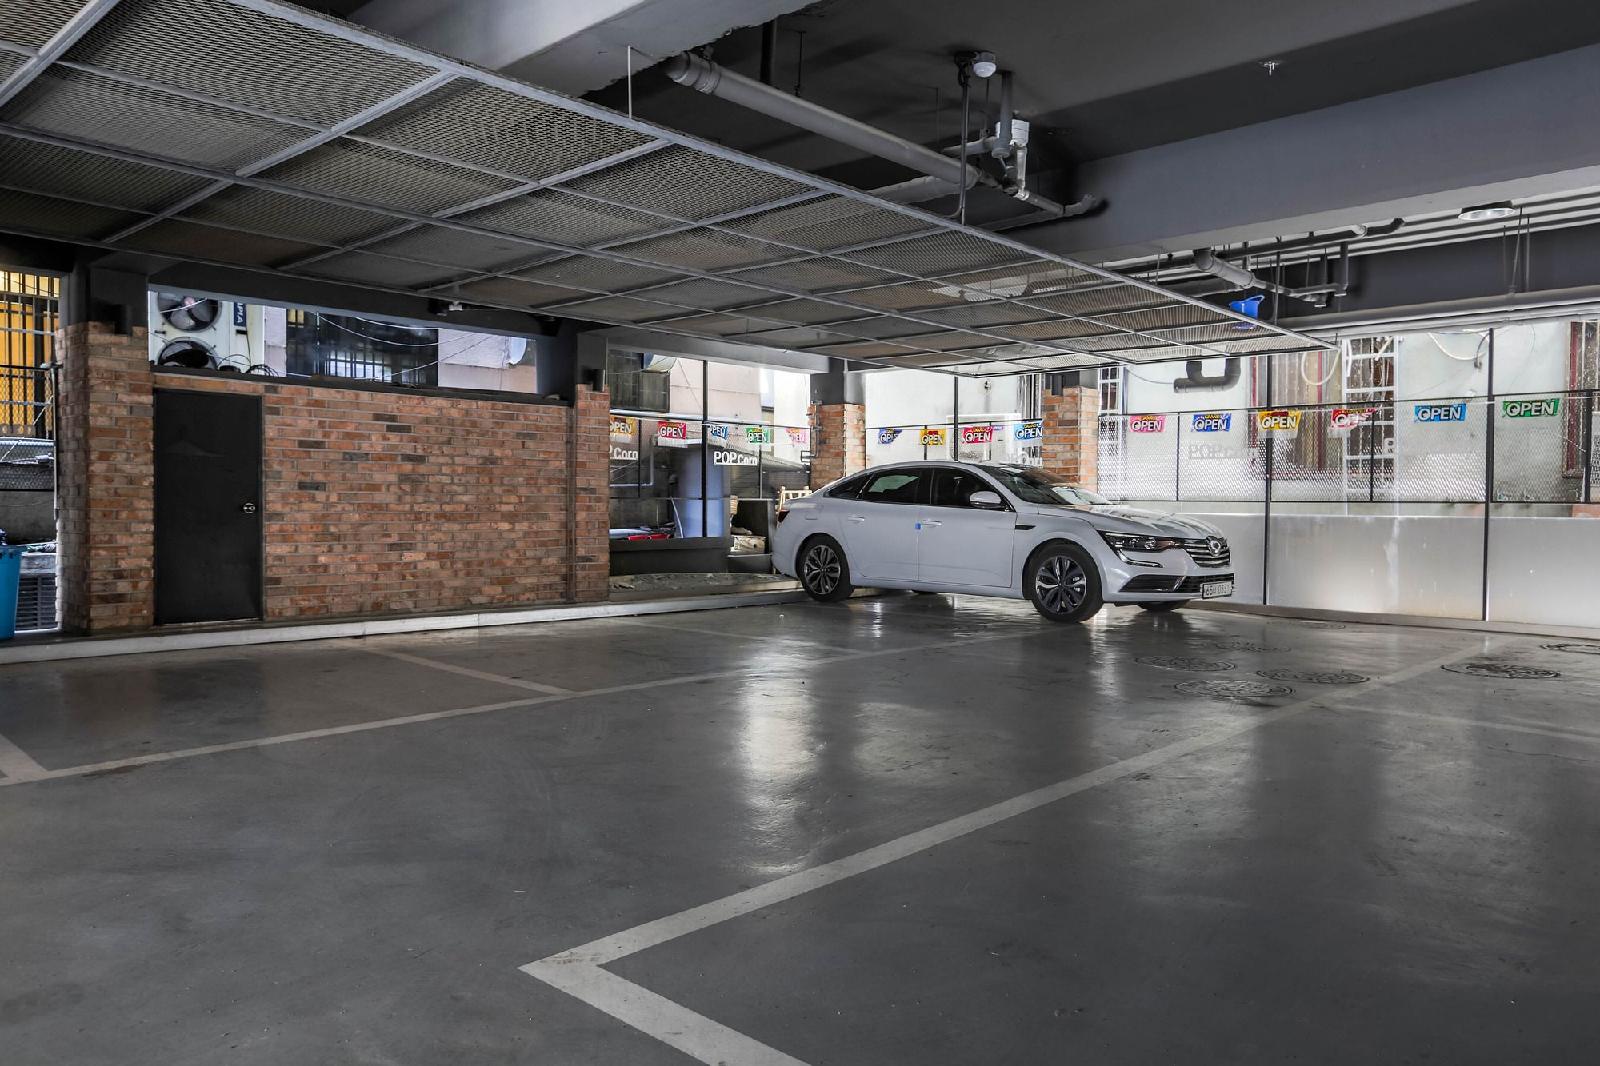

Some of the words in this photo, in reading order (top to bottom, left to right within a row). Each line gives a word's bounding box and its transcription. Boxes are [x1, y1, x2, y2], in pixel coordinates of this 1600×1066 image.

[1418, 405, 1461, 421] OPEN
[1507, 402, 1555, 417] OPEN
[1132, 420, 1162, 431] OPEN
[1194, 419, 1227, 430] OPEN
[1261, 416, 1296, 429] OPEN
[660, 426, 684, 438] OPEN
[966, 432, 991, 443] OPEN
[1016, 428, 1043, 440] OPEN
[922, 434, 943, 445] OPEN
